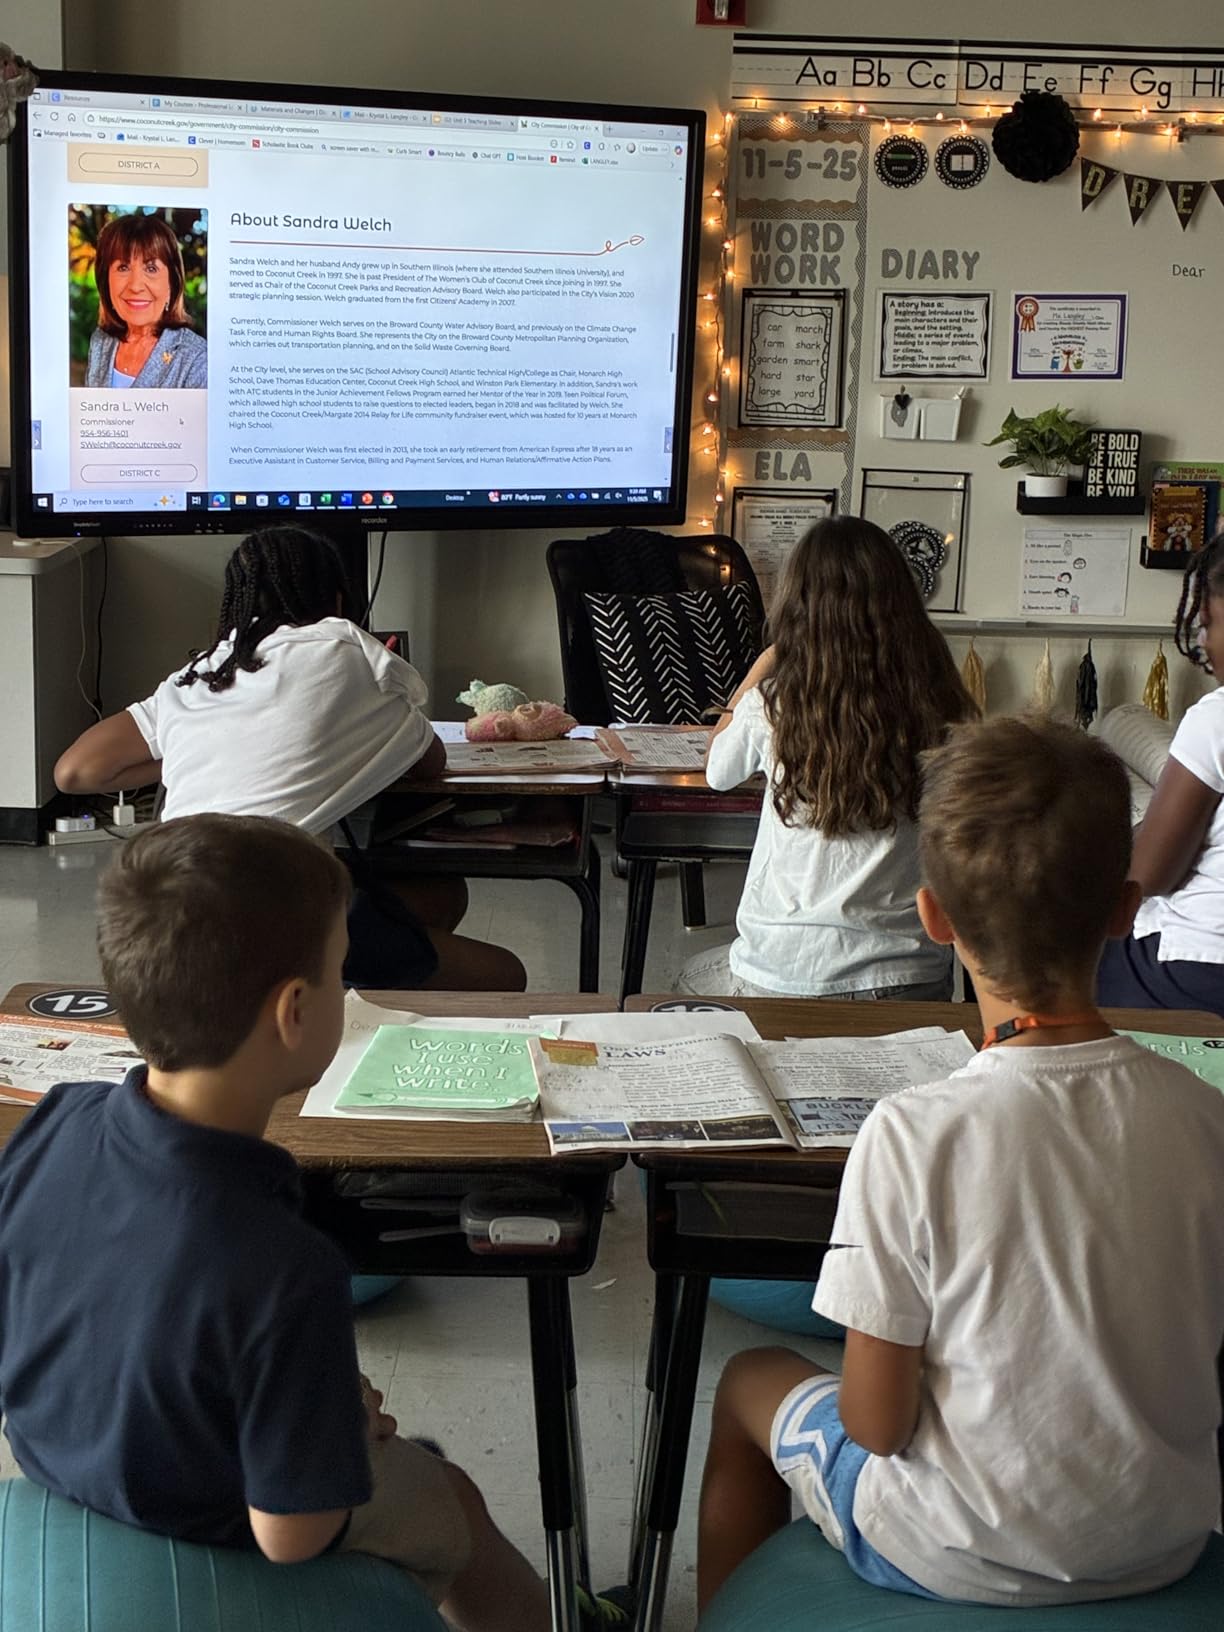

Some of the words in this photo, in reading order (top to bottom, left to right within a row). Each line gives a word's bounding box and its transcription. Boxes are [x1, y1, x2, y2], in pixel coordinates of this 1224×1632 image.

[796, 56, 836, 86] Aa
[853, 58, 890, 87] Bb
[908, 60, 946, 88] Cc
[966, 61, 1003, 90] Dd
[1024, 64, 1058, 92] Ee
[1080, 66, 1114, 94] Ff
[1131, 68, 1171, 108] Gg
[743, 148, 857, 181] 11-5-25
[230, 213, 278, 227] About
[283, 215, 338, 230] Sandra
[344, 217, 392, 231] Welch
[751, 221, 844, 253] WORD
[229, 257, 254, 266] Sandra
[256, 258, 279, 266] Welch
[280, 259, 294, 267] and
[296, 259, 307, 267] her
[309, 260, 340, 268] husband
[342, 260, 360, 270] Andy
[361, 263, 379, 271] grew
[380, 263, 390, 271] up
[391, 262, 398, 270] in
[399, 262, 430, 271] Southern
[432, 263, 453, 271] Illinois
[492, 265, 522, 273] attended
[524, 266, 553, 274] Southern
[555, 267, 575, 275] Illinois
[612, 268, 624, 276] and
[751, 253, 840, 285] WORK
[881, 248, 980, 280] DIARY
[1172, 264, 1205, 278] Dear
[228, 291, 260, 302] strategic
[262, 292, 294, 302] planning
[324, 294, 346, 302] Welch
[347, 294, 383, 304] graduated
[384, 295, 401, 303] from
[402, 295, 414, 303] the
[415, 296, 428, 304] first
[458, 297, 489, 307] Academy
[490, 297, 497, 305] in
[898, 301, 918, 309] story
[266, 318, 317, 326] Commissioner
[319, 319, 341, 327] Welch
[376, 320, 387, 328] the
[389, 320, 418, 328] Broward
[419, 320, 443, 330] County
[444, 321, 464, 329] Water
[466, 321, 493, 331] Advisory
[517, 322, 530, 330] and
[531, 323, 563, 333] previously
[574, 323, 585, 331] the
[586, 324, 610, 332] Climate
[612, 324, 636, 334] Change
[795, 325, 823, 334] march
[763, 338, 784, 347] farm
[795, 341, 821, 350] shark
[756, 355, 788, 365] garden
[793, 358, 819, 366] smart
[761, 371, 782, 379] hard
[759, 387, 780, 397] large
[794, 390, 815, 398] yard
[80, 402, 119, 412] Sandra
[123, 402, 132, 412] L.
[135, 402, 168, 412] Welch
[80, 418, 134, 426] Commissioner
[80, 441, 182, 449] SWelch@coconutcreek.gov
[1108, 434, 1139, 450] BOLD
[755, 451, 812, 481] ELA
[1108, 452, 1137, 468] TRUE
[1088, 468, 1102, 484] BE
[1106, 469, 1136, 484] KIND
[72, 498, 86, 506] Type
[46, 995, 108, 1012] 15
[438, 1054, 493, 1065] use
[605, 1050, 666, 1058] LAWS
[393, 1064, 486, 1077] when
